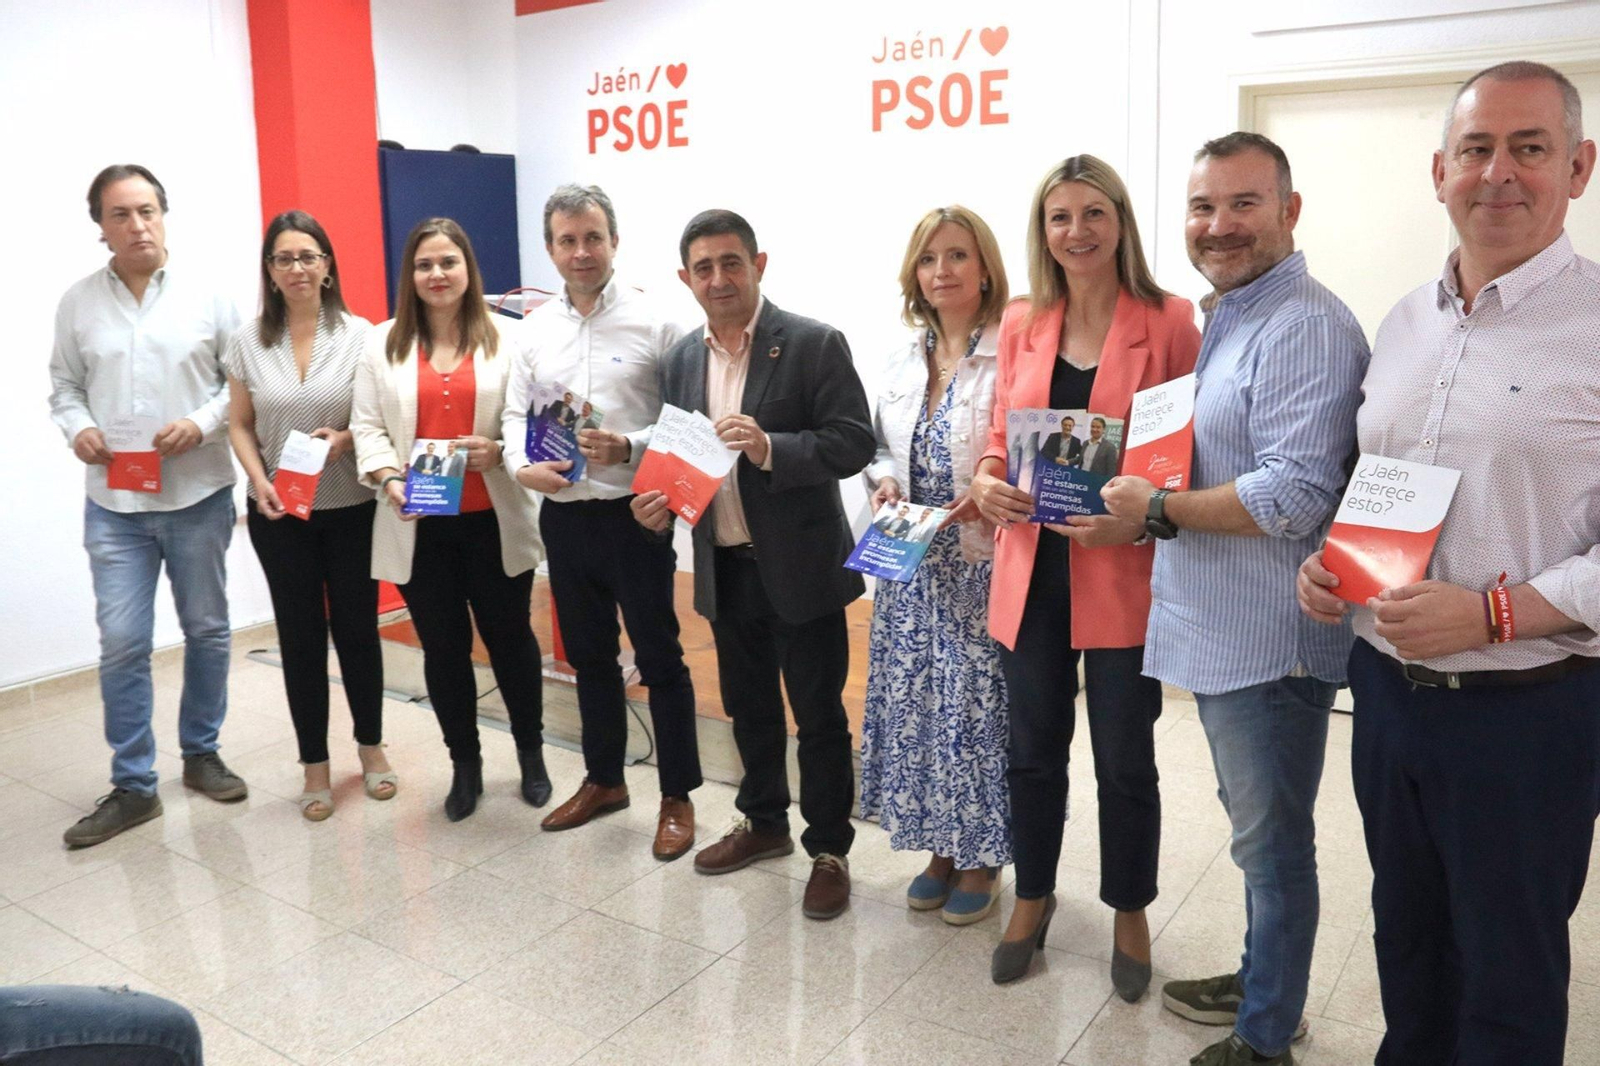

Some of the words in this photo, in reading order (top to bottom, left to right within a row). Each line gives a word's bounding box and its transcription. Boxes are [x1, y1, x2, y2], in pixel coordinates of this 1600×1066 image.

[872, 31, 944, 63] Jaén
[587, 67, 641, 96] Jaén
[872, 69, 1009, 132] PSOE
[588, 100, 689, 154] PSOE
[1134, 402, 1174, 421] merece
[1132, 417, 1163, 435] esto?
[1038, 466, 1071, 481] Jaén
[1358, 463, 1409, 482] ¿Jaén
[1043, 478, 1053, 486] se
[1054, 480, 1088, 492] estanca
[1353, 480, 1416, 502] merece
[1040, 491, 1082, 503] promesas
[1347, 497, 1394, 515] esto?
[1039, 499, 1092, 514] incumplidas
[865, 534, 895, 547] Jaén
